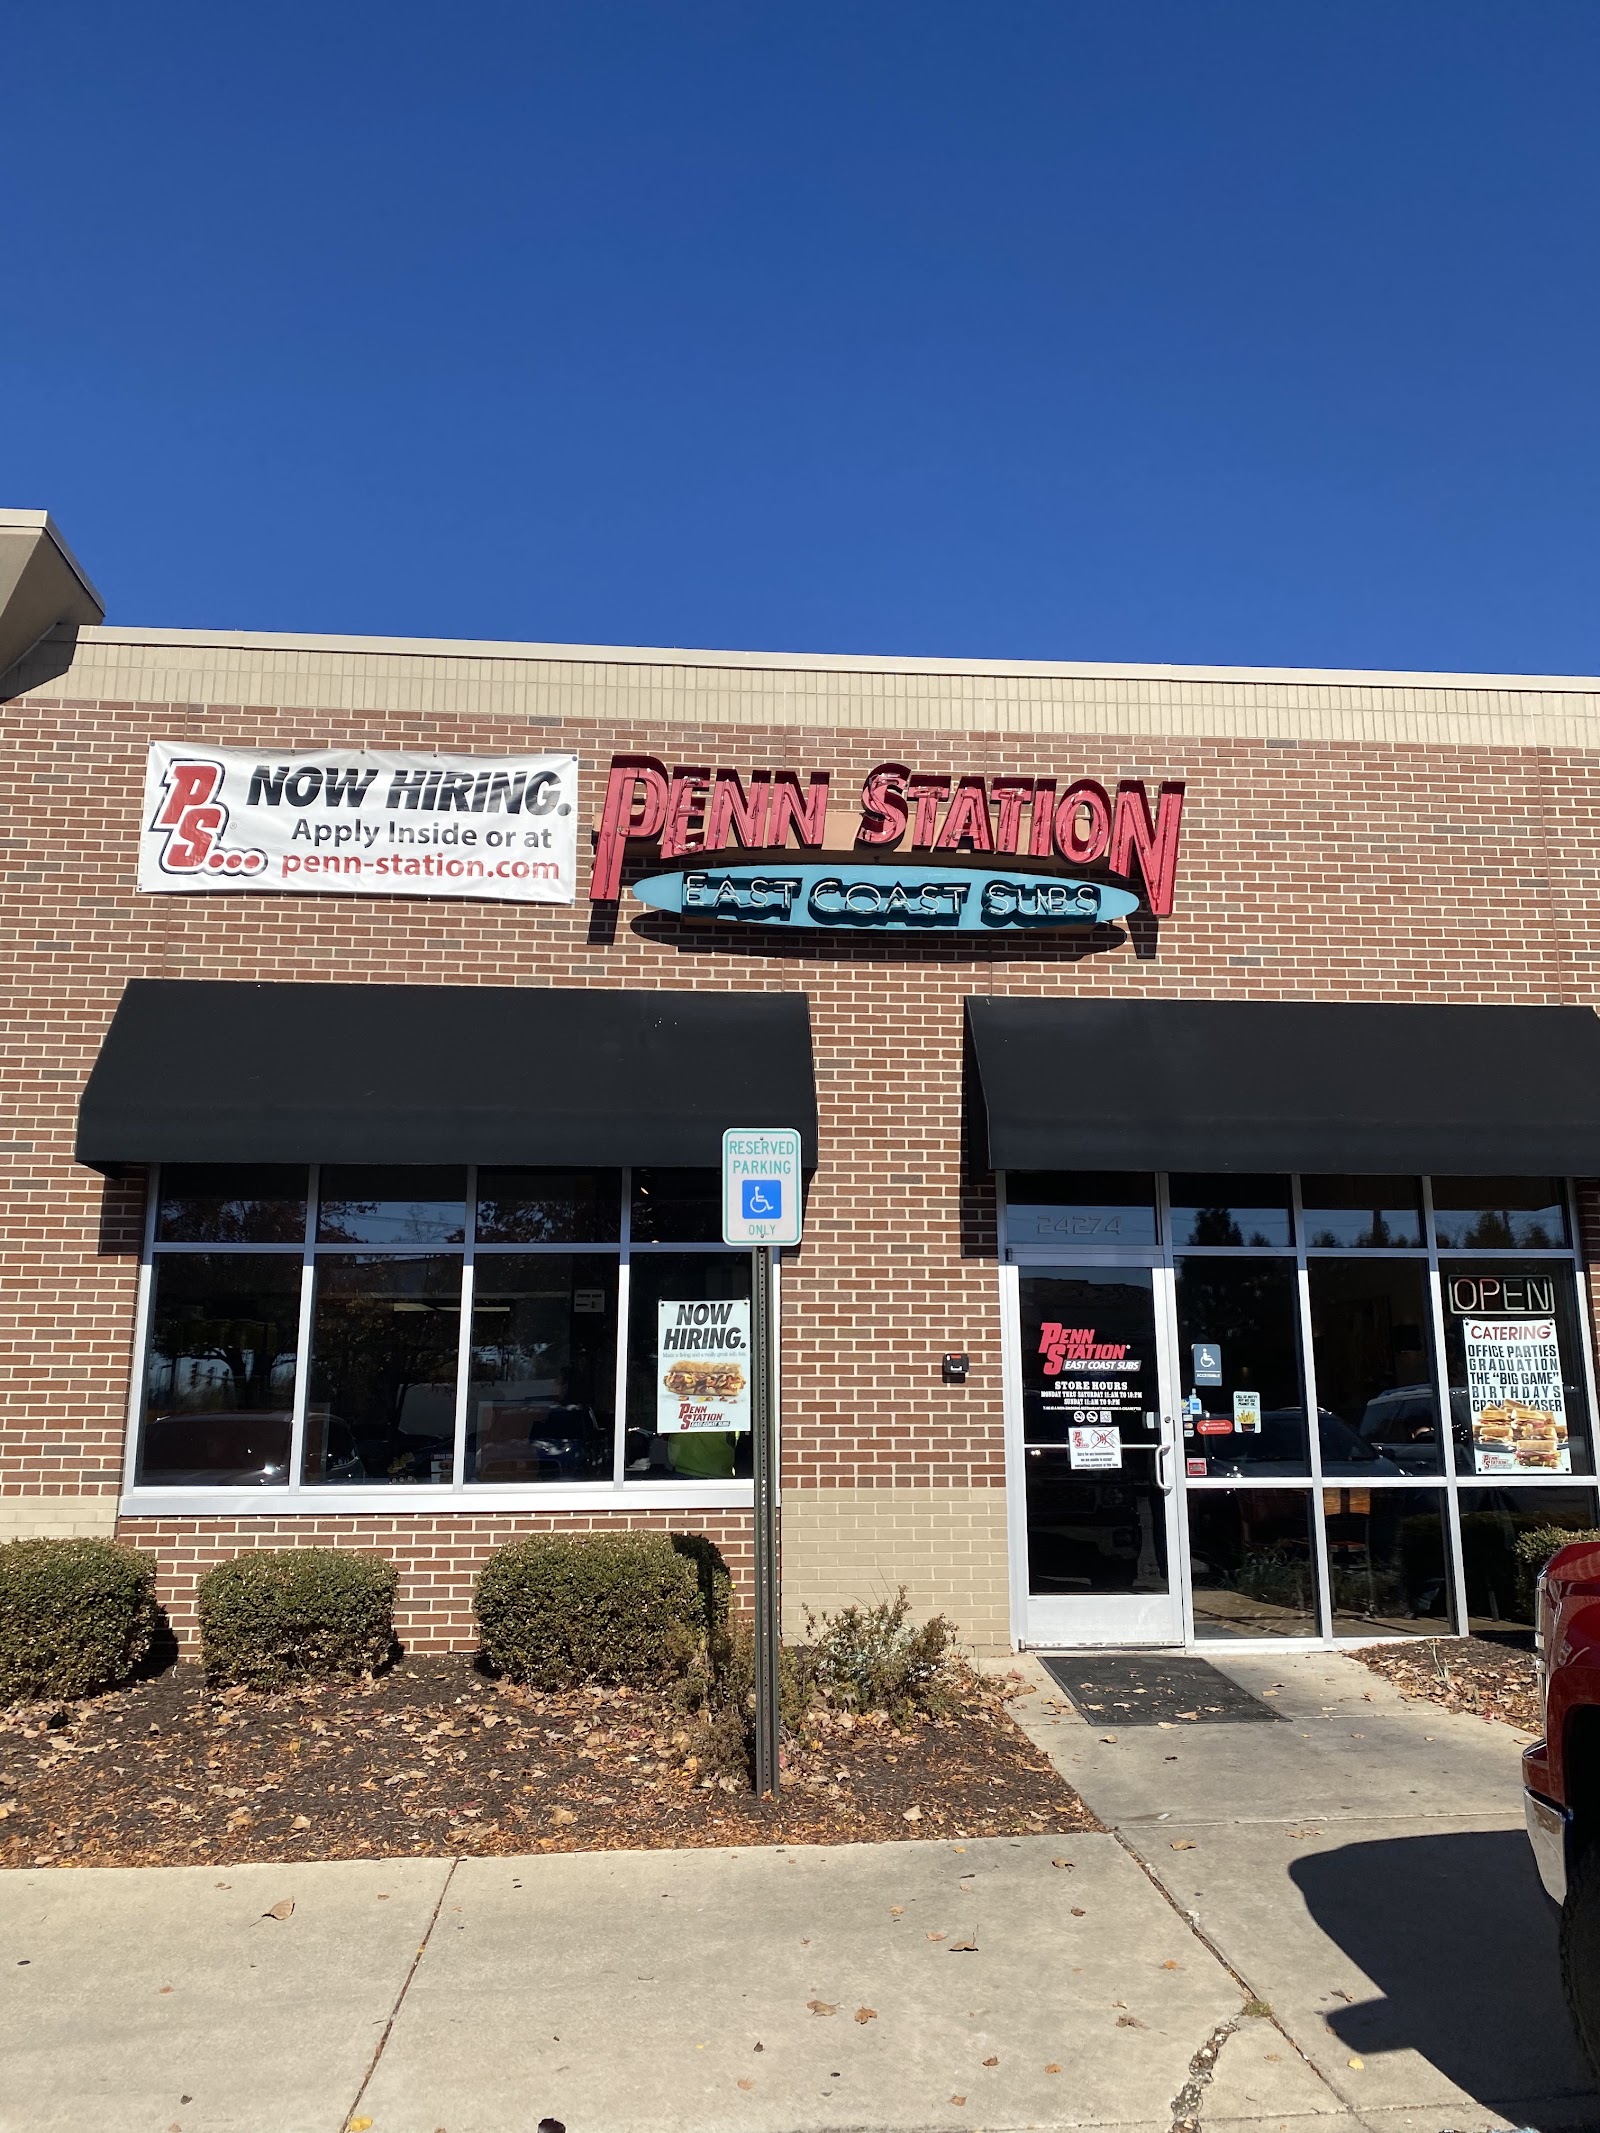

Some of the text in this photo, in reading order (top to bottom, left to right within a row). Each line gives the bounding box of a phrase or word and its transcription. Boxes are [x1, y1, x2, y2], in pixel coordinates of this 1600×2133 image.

[246, 766, 572, 816] NOW HIRING.
[291, 818, 552, 849] Apply Inside or at
[590, 755, 1185, 917] PENN STATION
[281, 852, 559, 880] penn-station.com
[685, 873, 1098, 917] EAST COAST SUBS
[729, 1141, 794, 1155] RESERVED
[733, 1160, 791, 1175] PARKING
[748, 1224, 776, 1236] ONLY
[1037, 1216, 1122, 1236] 24274
[1453, 1279, 1550, 1311] OPEN
[676, 1303, 733, 1326] NOW
[663, 1327, 747, 1351] HIRING.
[1038, 1322, 1095, 1353] PENN
[1470, 1325, 1551, 1340] CATERING
[1467, 1344, 1557, 1358] OFFICE PARTIES
[1064, 1360, 1140, 1370] EAST COAST SUBS
[1469, 1358, 1559, 1371] GRADUATION
[1054, 1381, 1128, 1391] STORE HOURS
[1470, 1372, 1491, 1385] THE
[1472, 1385, 1561, 1398] BIRTHDAYS
[679, 1403, 707, 1419] PENN
[680, 1413, 723, 1430] STATION
